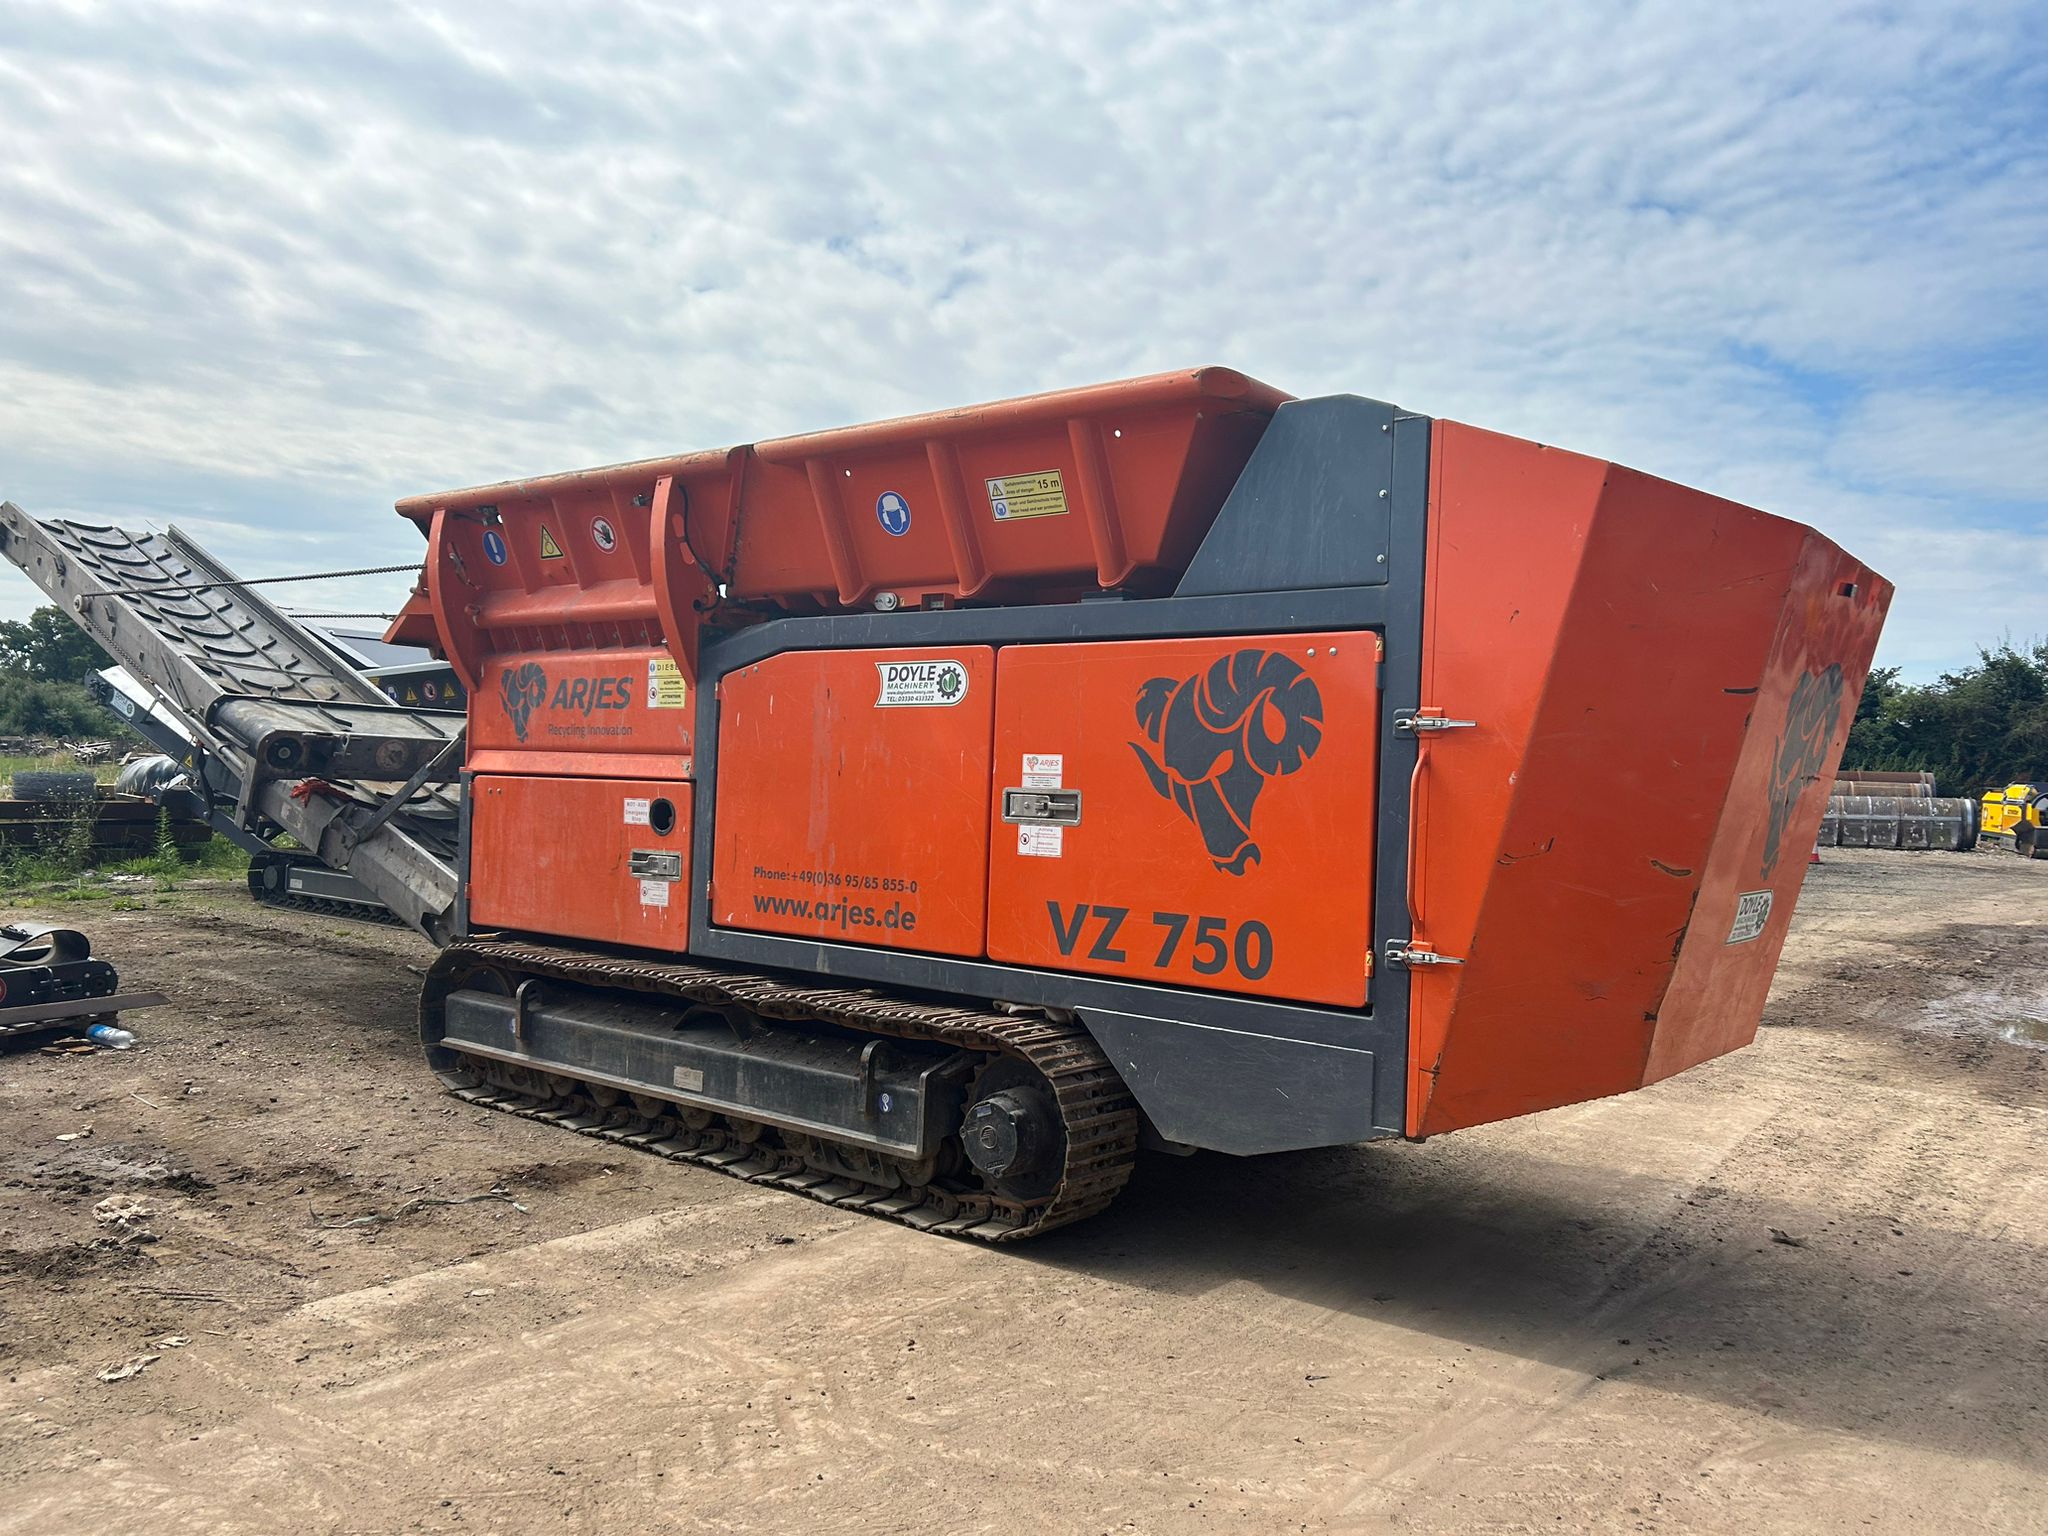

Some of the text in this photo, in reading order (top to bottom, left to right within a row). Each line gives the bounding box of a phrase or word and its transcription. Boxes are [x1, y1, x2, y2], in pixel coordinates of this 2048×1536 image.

[1037, 479, 1049, 489] 15
[1050, 479, 1060, 488] m
[887, 665, 937, 682] DOYLE
[887, 682, 935, 690] MACHINERY
[549, 676, 634, 717] ARJES
[548, 724, 633, 739] Recycling Innovation
[1039, 759, 1060, 768] ARJES
[845, 874, 879, 890] 95/85
[882, 878, 918, 894] 855-0
[753, 894, 917, 931] www.arjes.de
[1739, 895, 1763, 915] DOYLE
[1046, 900, 1273, 981] VZ 750
